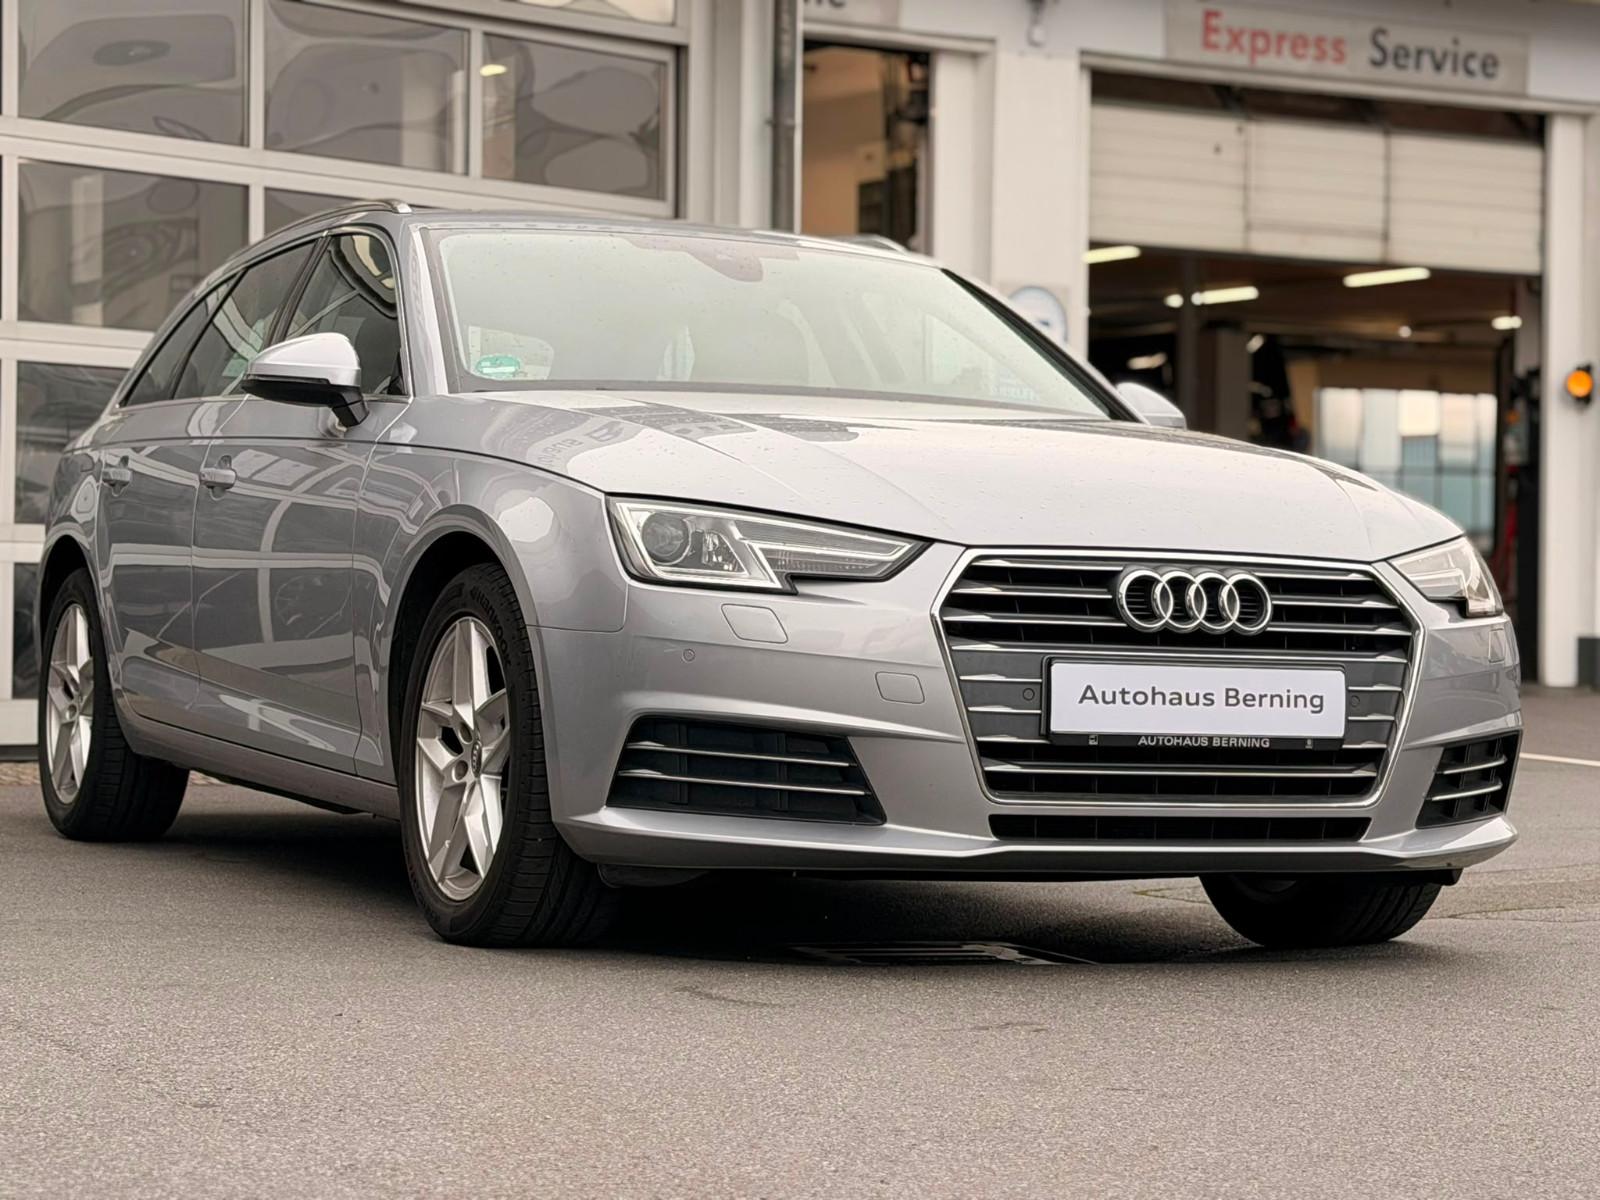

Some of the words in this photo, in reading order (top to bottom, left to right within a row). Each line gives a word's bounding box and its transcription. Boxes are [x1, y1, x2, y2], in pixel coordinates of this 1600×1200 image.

[1202, 9, 1347, 64] Express
[1369, 26, 1500, 79] Service
[1078, 684, 1215, 706] Autohaus
[1224, 687, 1324, 713] Berning
[1137, 736, 1208, 747] AUTOHAUS
[1212, 737, 1270, 748] BERNING
